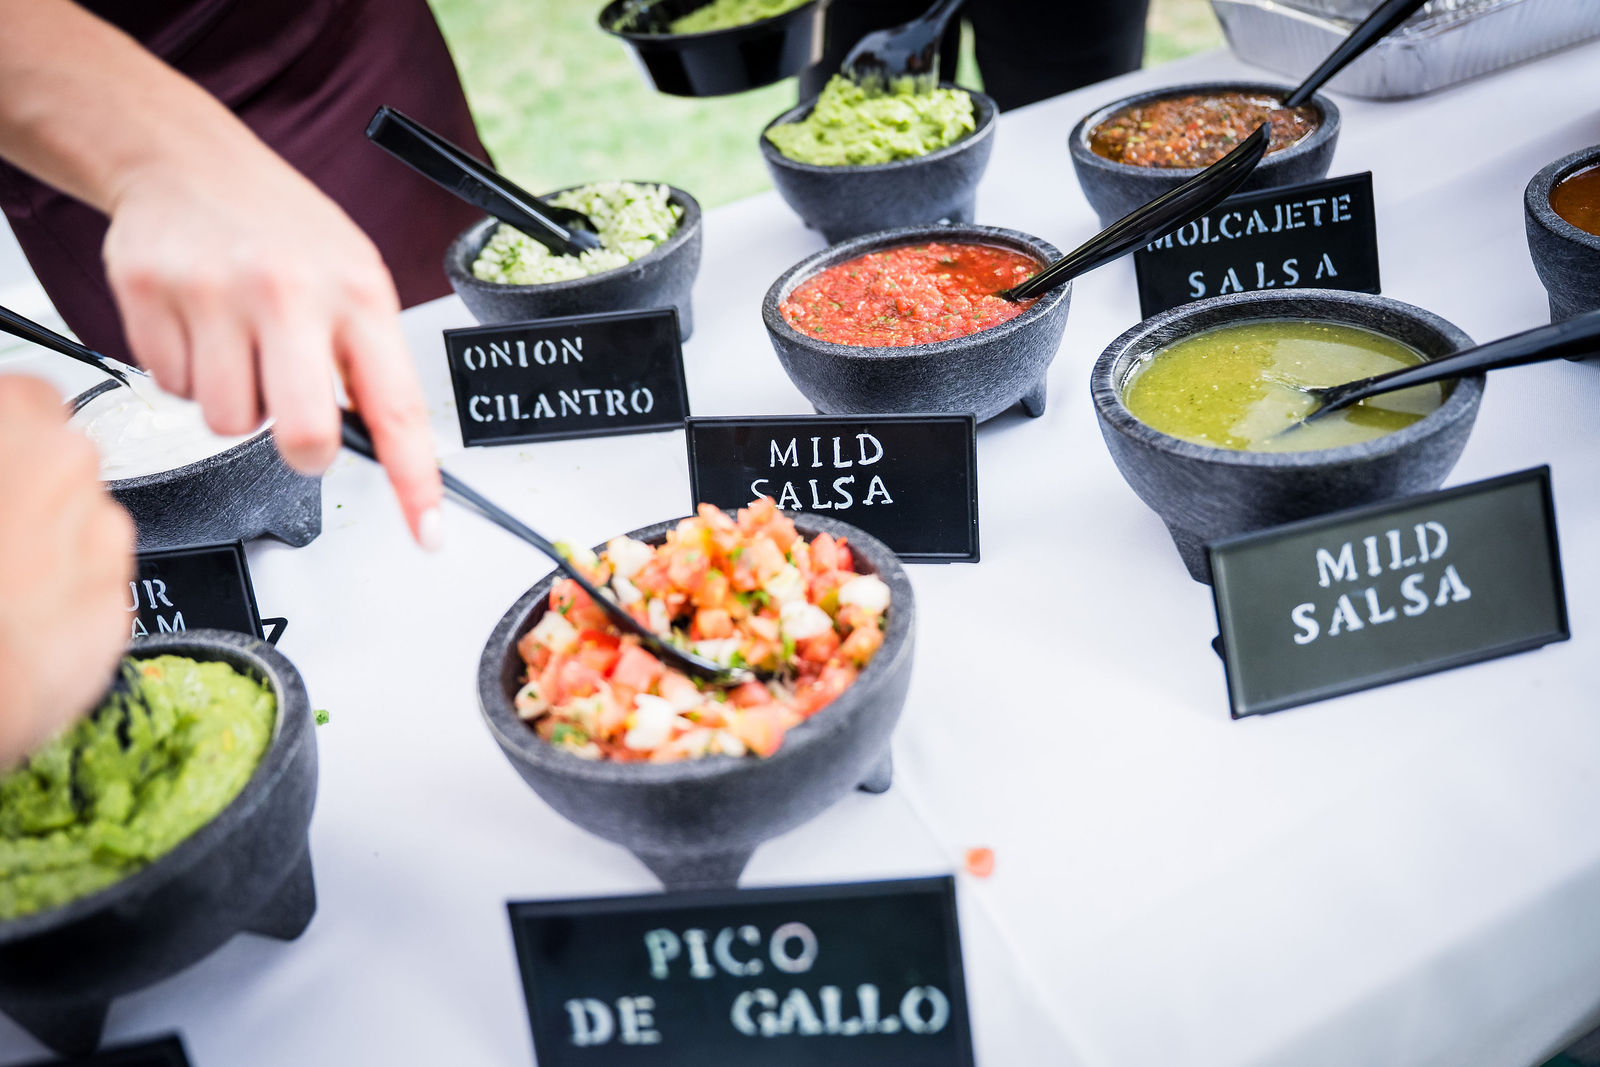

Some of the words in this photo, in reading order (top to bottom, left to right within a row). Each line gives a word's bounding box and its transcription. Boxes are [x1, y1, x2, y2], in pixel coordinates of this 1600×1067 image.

[1188, 252, 1338, 298] SALSA
[464, 336, 583, 371] ONION
[469, 387, 654, 422] CILANTRO
[769, 433, 884, 468] MILD
[1315, 520, 1449, 588] MILD
[1290, 564, 1472, 645] SALSA
[643, 921, 819, 980] PICO
[564, 995, 662, 1046] DE
[729, 983, 950, 1037] GALLO
